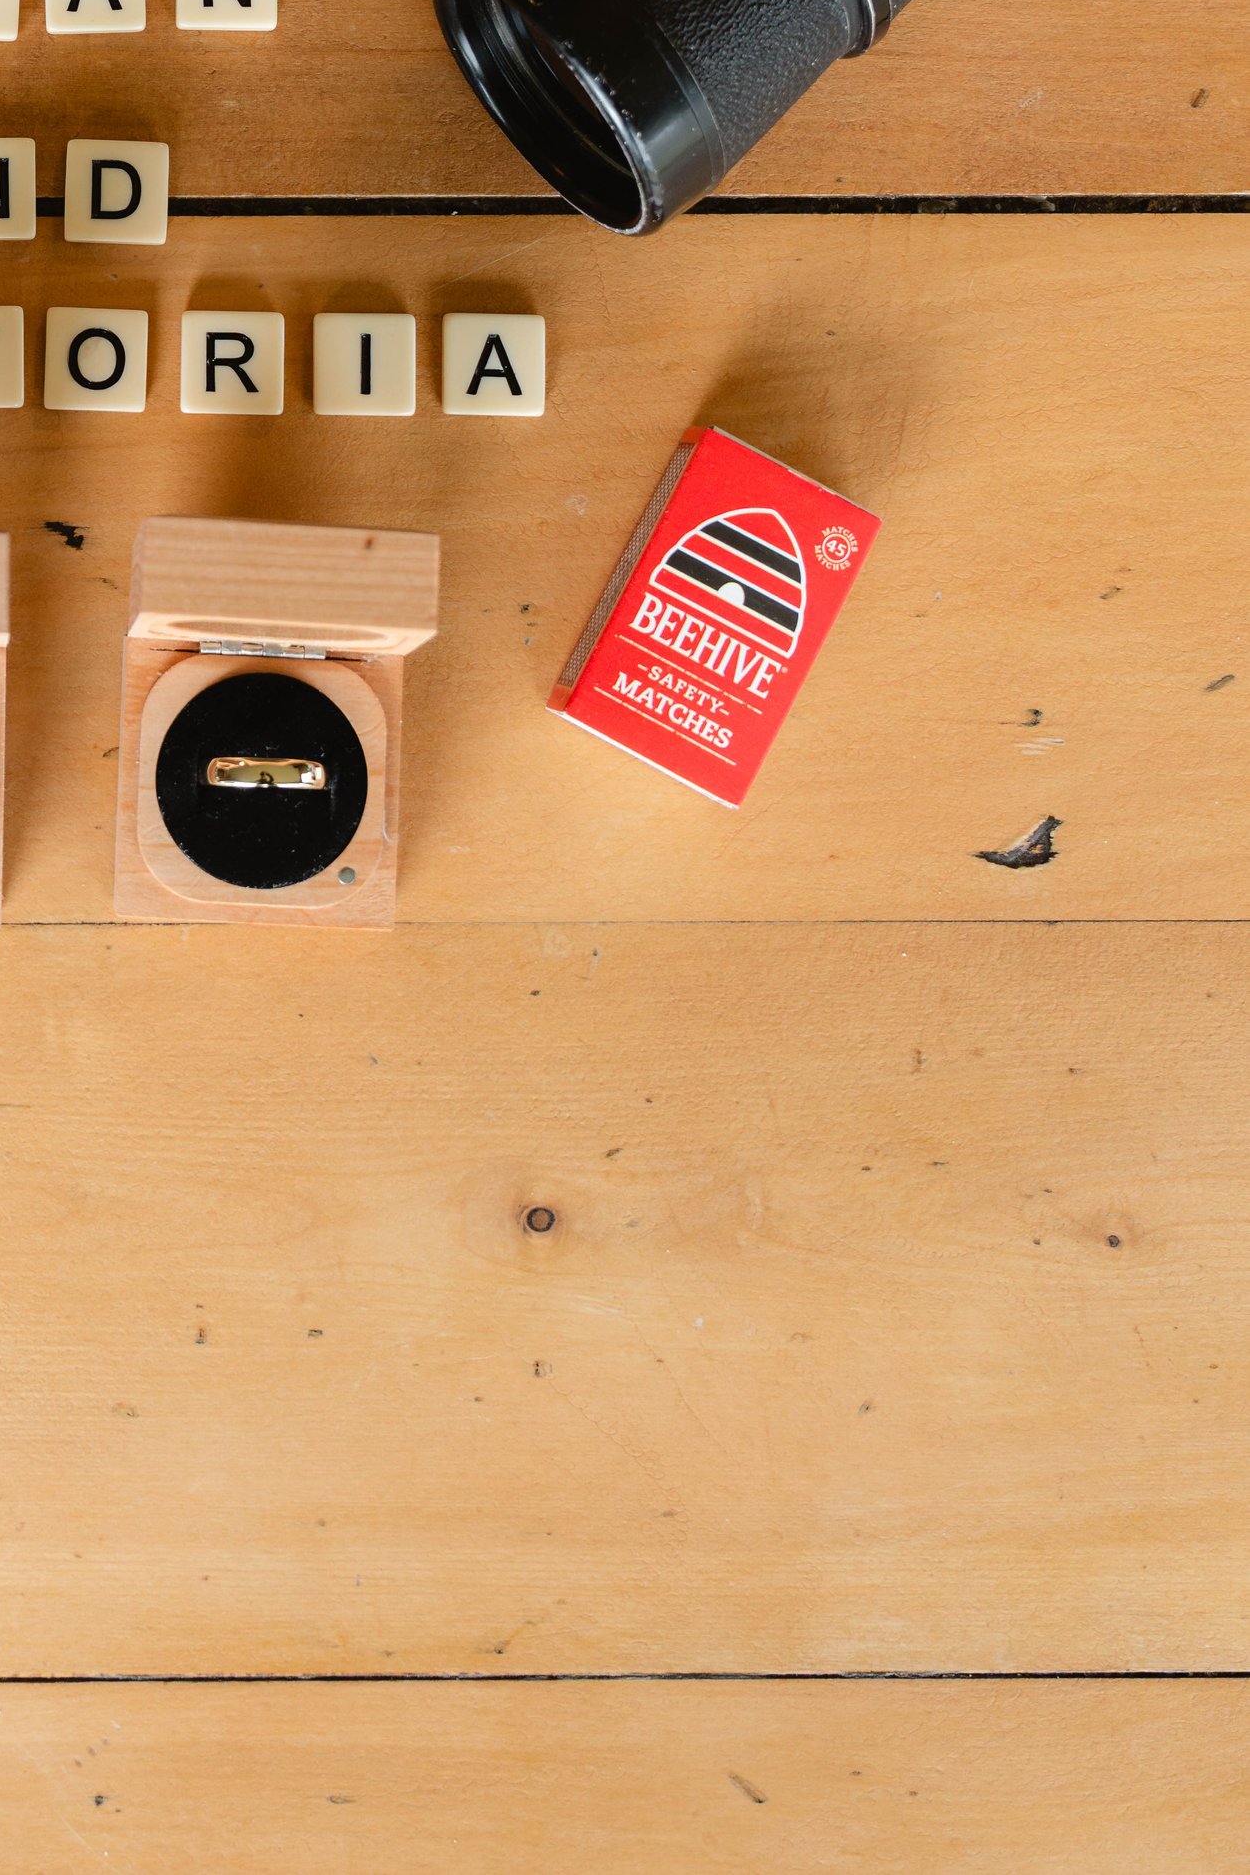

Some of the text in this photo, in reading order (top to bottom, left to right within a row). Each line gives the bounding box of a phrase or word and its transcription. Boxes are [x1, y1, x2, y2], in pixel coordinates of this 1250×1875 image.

[821, 526, 858, 553] MATCHES
[825, 539, 847, 557] 45
[814, 545, 851, 571] MATCHES
[629, 592, 783, 699] BEEHIVE
[612, 671, 734, 749] MATCHES
